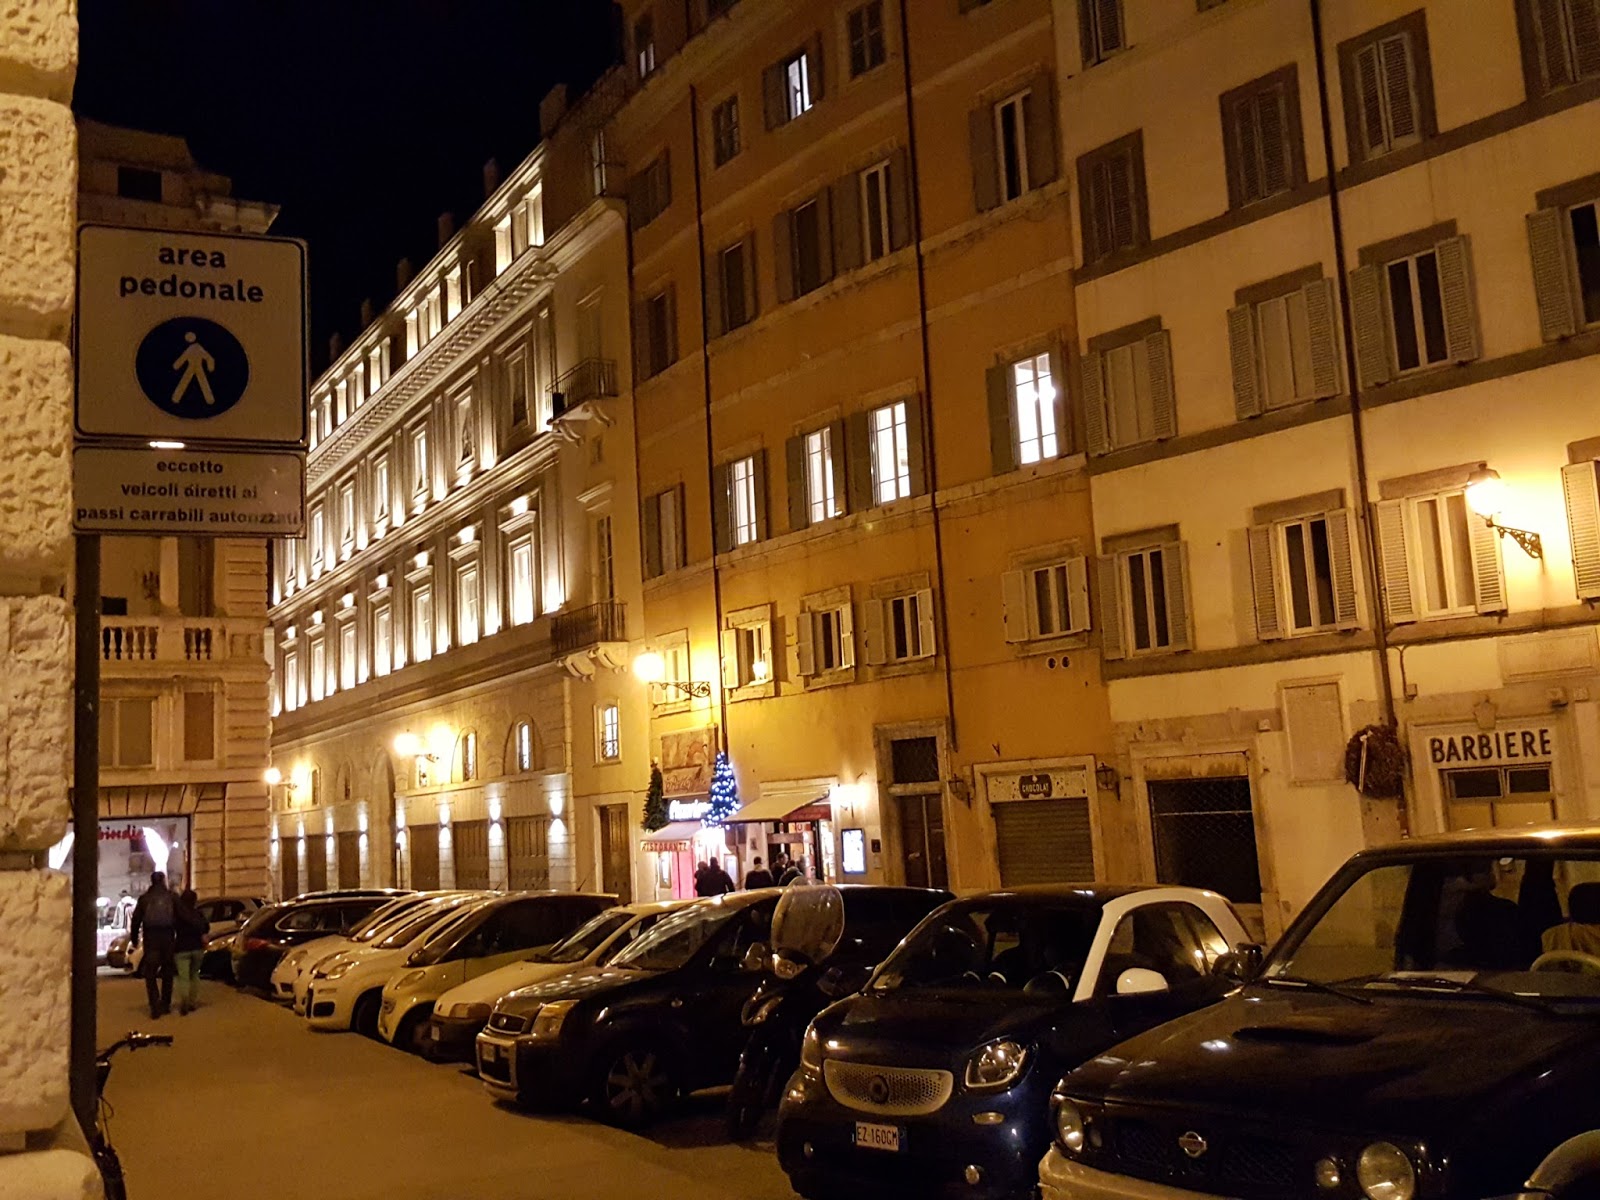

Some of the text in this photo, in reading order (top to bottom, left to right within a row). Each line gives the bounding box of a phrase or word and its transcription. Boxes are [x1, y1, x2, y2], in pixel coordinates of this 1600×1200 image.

[158, 246, 226, 269] area
[119, 274, 264, 304] pedonale
[156, 460, 223, 474] eccetto
[121, 482, 258, 499] veicoli diretti ai
[76, 506, 124, 522] passi
[129, 507, 204, 523] carrabili
[1430, 728, 1552, 764] BARBIERE
[1022, 782, 1049, 793] CHOCOLAT
[641, 841, 687, 852] RISTORANTE
[857, 1126, 868, 1142] EZ
